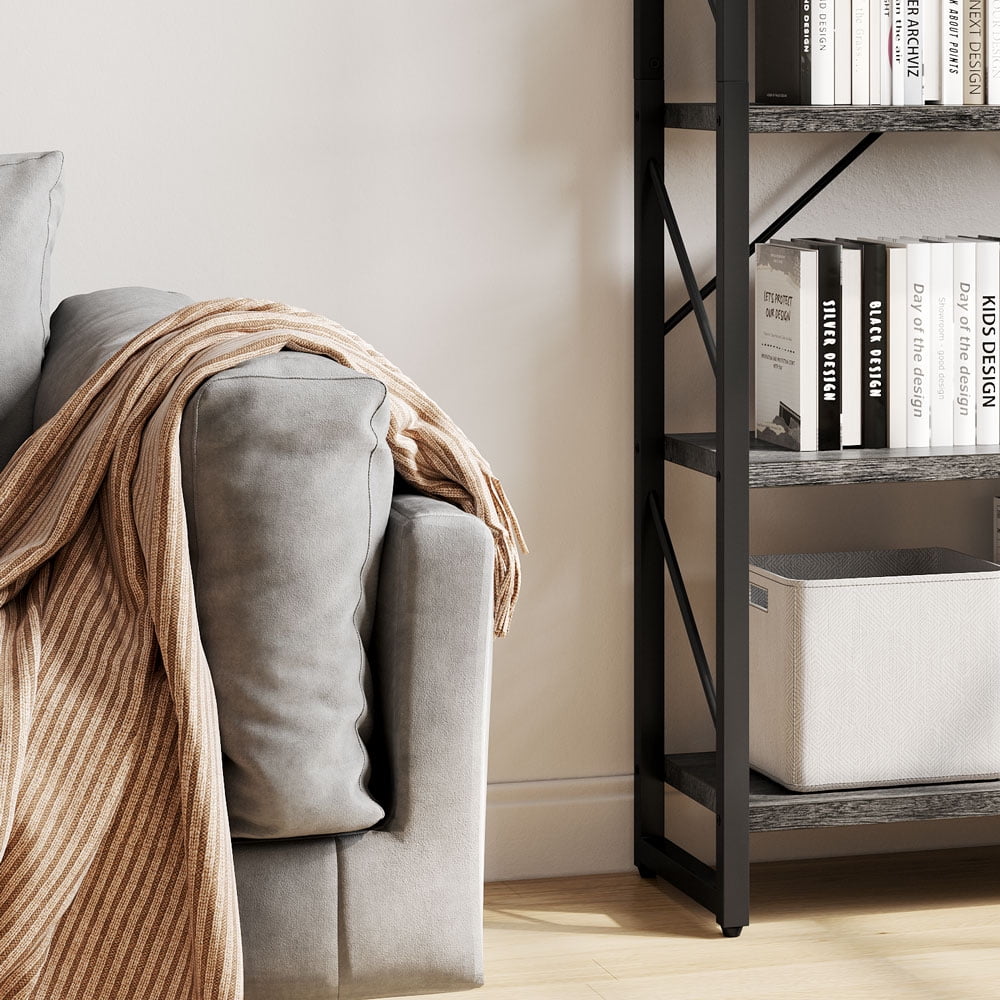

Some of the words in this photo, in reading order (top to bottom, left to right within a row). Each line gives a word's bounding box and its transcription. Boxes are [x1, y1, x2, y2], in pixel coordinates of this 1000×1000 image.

[949, 9, 958, 37] ABOUT
[969, 0, 981, 35] NEXT
[993, 3, 1000, 35] OUR
[908, 19, 918, 77] ARCHVIZ
[949, 42, 958, 74] POINTS
[993, 37, 1000, 79] DESIGN
[969, 43, 981, 95] DESIGN
[911, 284, 924, 313] Day
[957, 282, 970, 311] Day
[983, 296, 995, 336] KIDS
[823, 301, 836, 346] SILVER
[869, 301, 881, 342] BLACK
[914, 318, 924, 333] of
[960, 316, 970, 332] of
[914, 338, 924, 362] the
[960, 336, 970, 360] the
[823, 353, 836, 401] DESIGN
[869, 350, 881, 397] DESIGN
[911, 368, 924, 417] design
[957, 366, 970, 415] design
[983, 342, 995, 407] DESIGN
